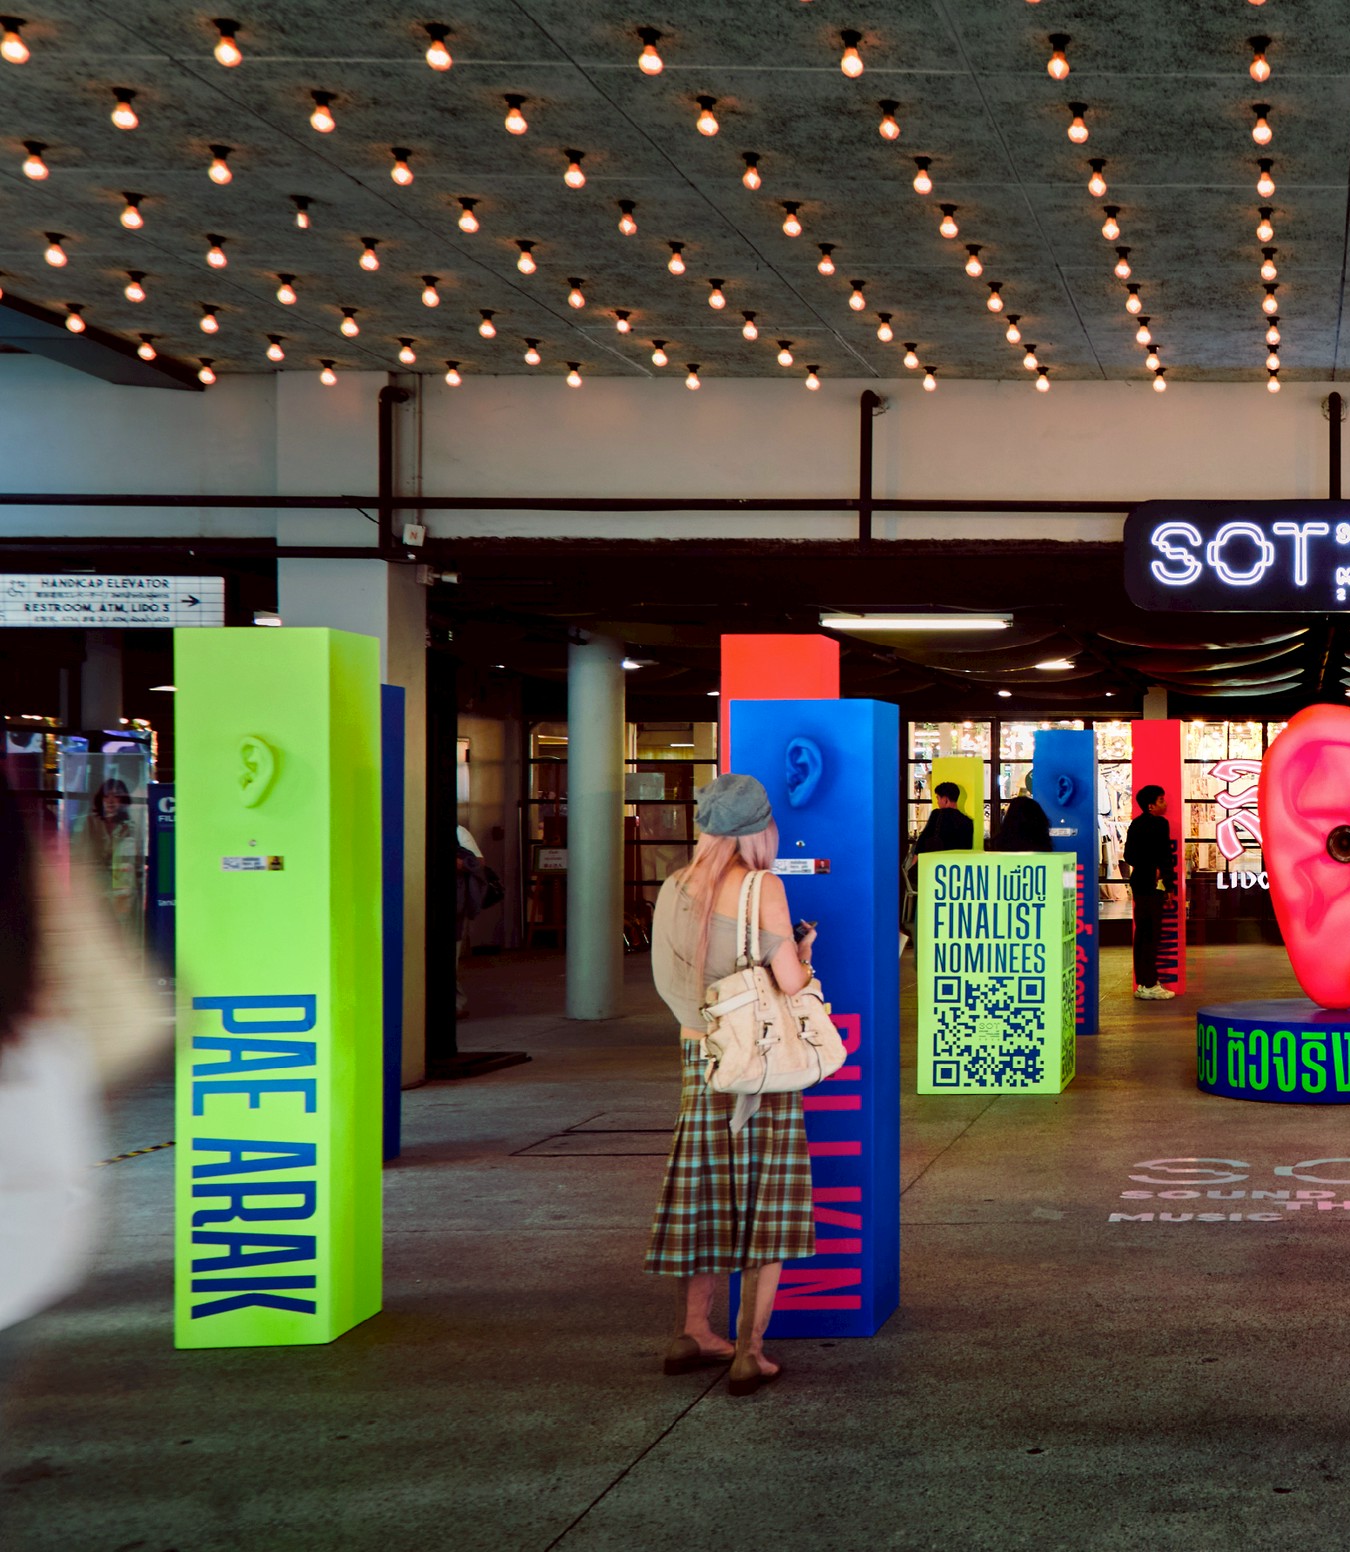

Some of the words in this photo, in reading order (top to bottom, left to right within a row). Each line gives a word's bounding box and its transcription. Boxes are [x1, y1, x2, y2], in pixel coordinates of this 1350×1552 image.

[1151, 522, 1330, 586] SOT
[41, 578, 103, 588] HANDICAP
[106, 579, 170, 589] ELEVATOR
[131, 603, 159, 612] LIDO
[163, 603, 170, 612] 3
[934, 864, 989, 901] SCAN
[934, 902, 1046, 939] FINALIST
[934, 942, 1046, 974] NOMINEES
[192, 994, 316, 1116] PAE
[1119, 1190, 1336, 1199] SOUND
[191, 1138, 316, 1319] ARAK
[1107, 1213, 1284, 1222] MUSIC
